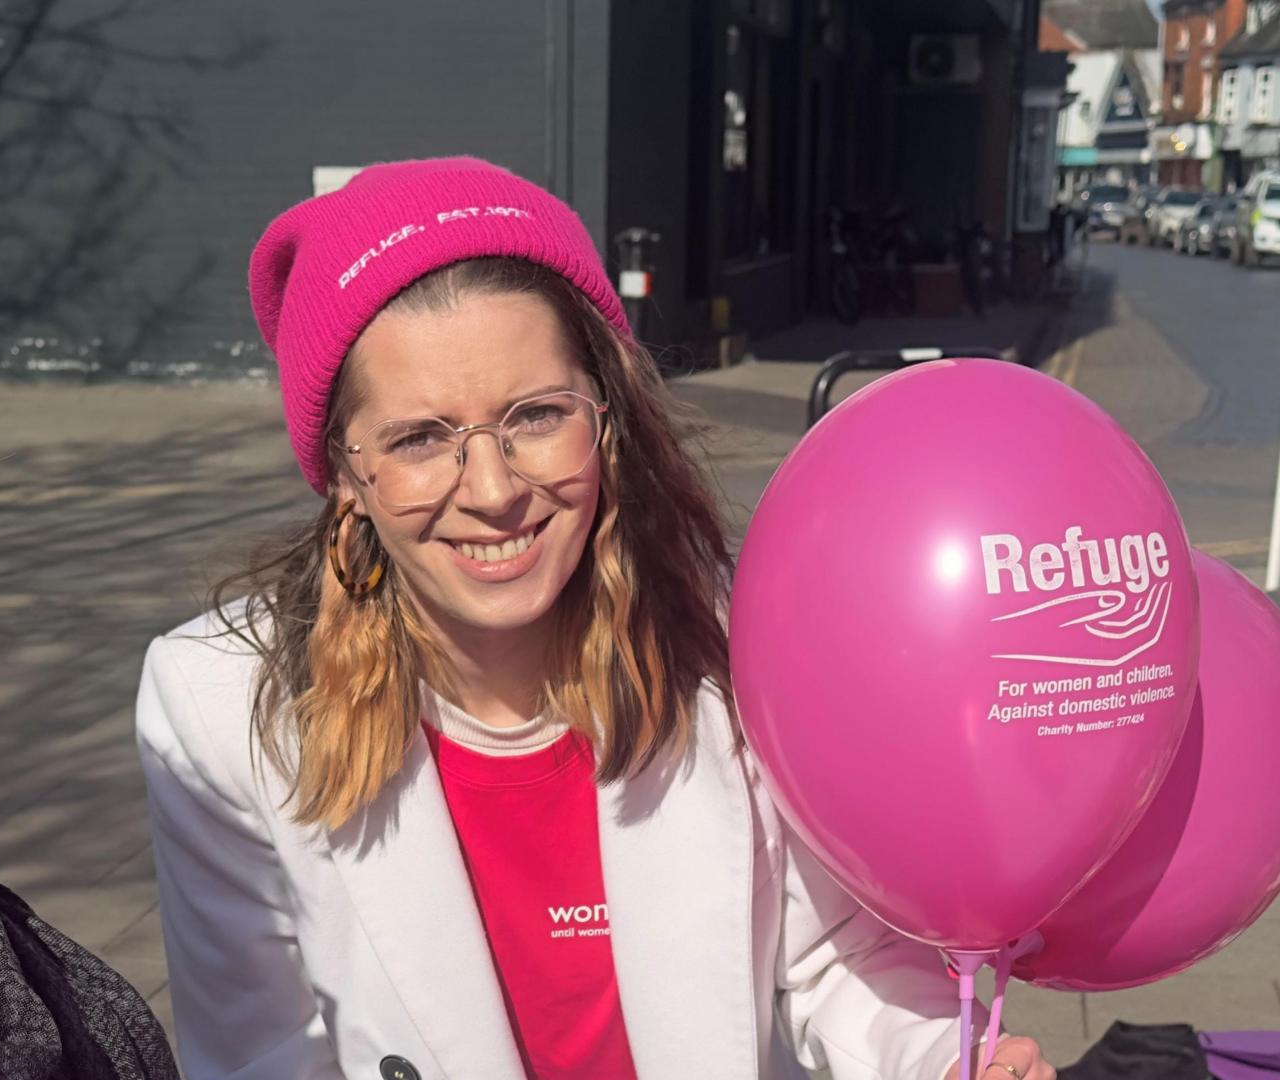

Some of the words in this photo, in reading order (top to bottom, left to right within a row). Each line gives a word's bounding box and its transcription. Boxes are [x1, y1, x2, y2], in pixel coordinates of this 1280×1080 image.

[980, 526, 1169, 594] Refuge
[998, 680, 1028, 697] For
[1033, 675, 1092, 696] women
[1096, 670, 1123, 689] and
[1126, 664, 1174, 685] children.
[987, 701, 1054, 724] Against
[1058, 692, 1126, 716] domestic
[1037, 723, 1074, 737] Charity
[1076, 719, 1115, 733] Number:
[551, 928, 575, 938] until
